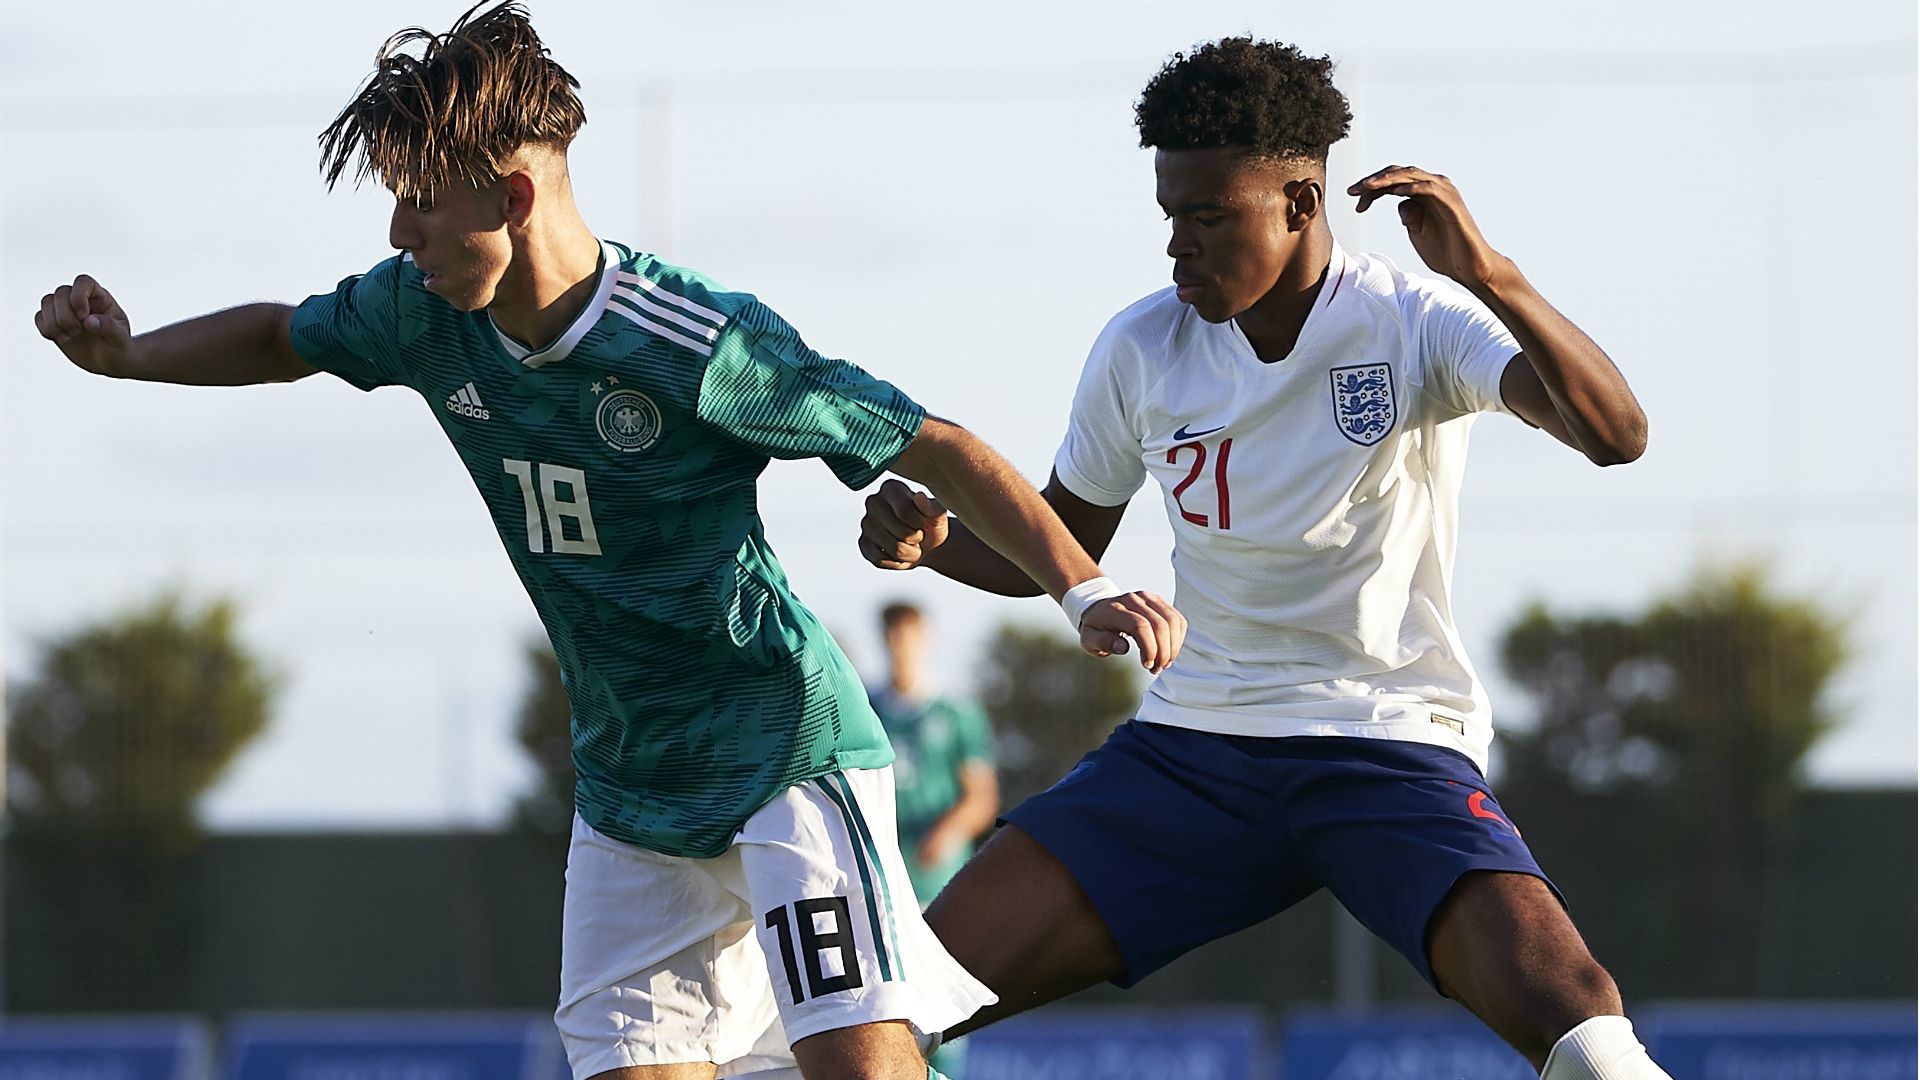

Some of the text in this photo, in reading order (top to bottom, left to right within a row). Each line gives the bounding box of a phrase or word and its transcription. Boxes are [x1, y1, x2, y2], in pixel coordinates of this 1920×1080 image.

[446, 400, 490, 420] adidas
[502, 458, 603, 556] 18
[1166, 438, 1233, 530] 21
[764, 895, 864, 1006] 18
